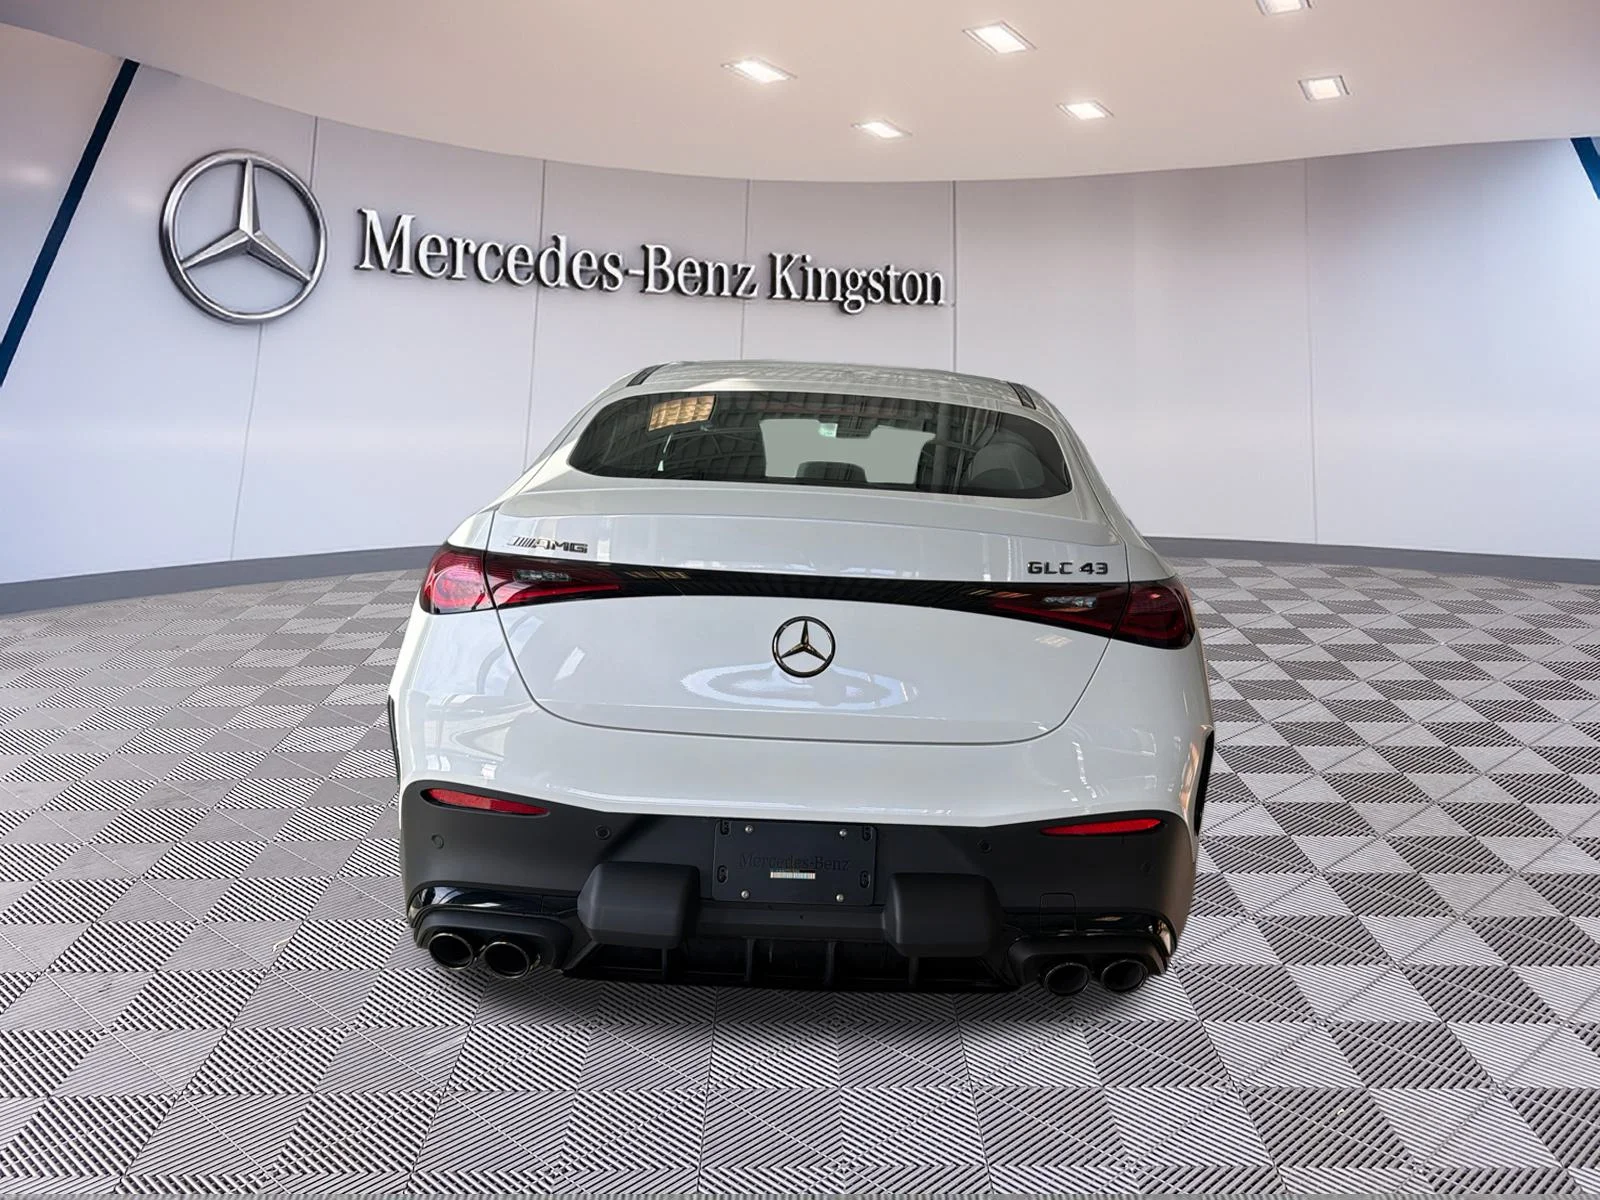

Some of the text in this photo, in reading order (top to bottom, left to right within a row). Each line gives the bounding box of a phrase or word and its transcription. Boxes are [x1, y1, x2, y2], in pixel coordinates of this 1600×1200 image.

[354, 207, 945, 314] Mercedes-Benz Kingston
[529, 537, 588, 554] AMG
[1027, 561, 1108, 575] GLC 43
[738, 852, 850, 871] Mercedes-Benz
